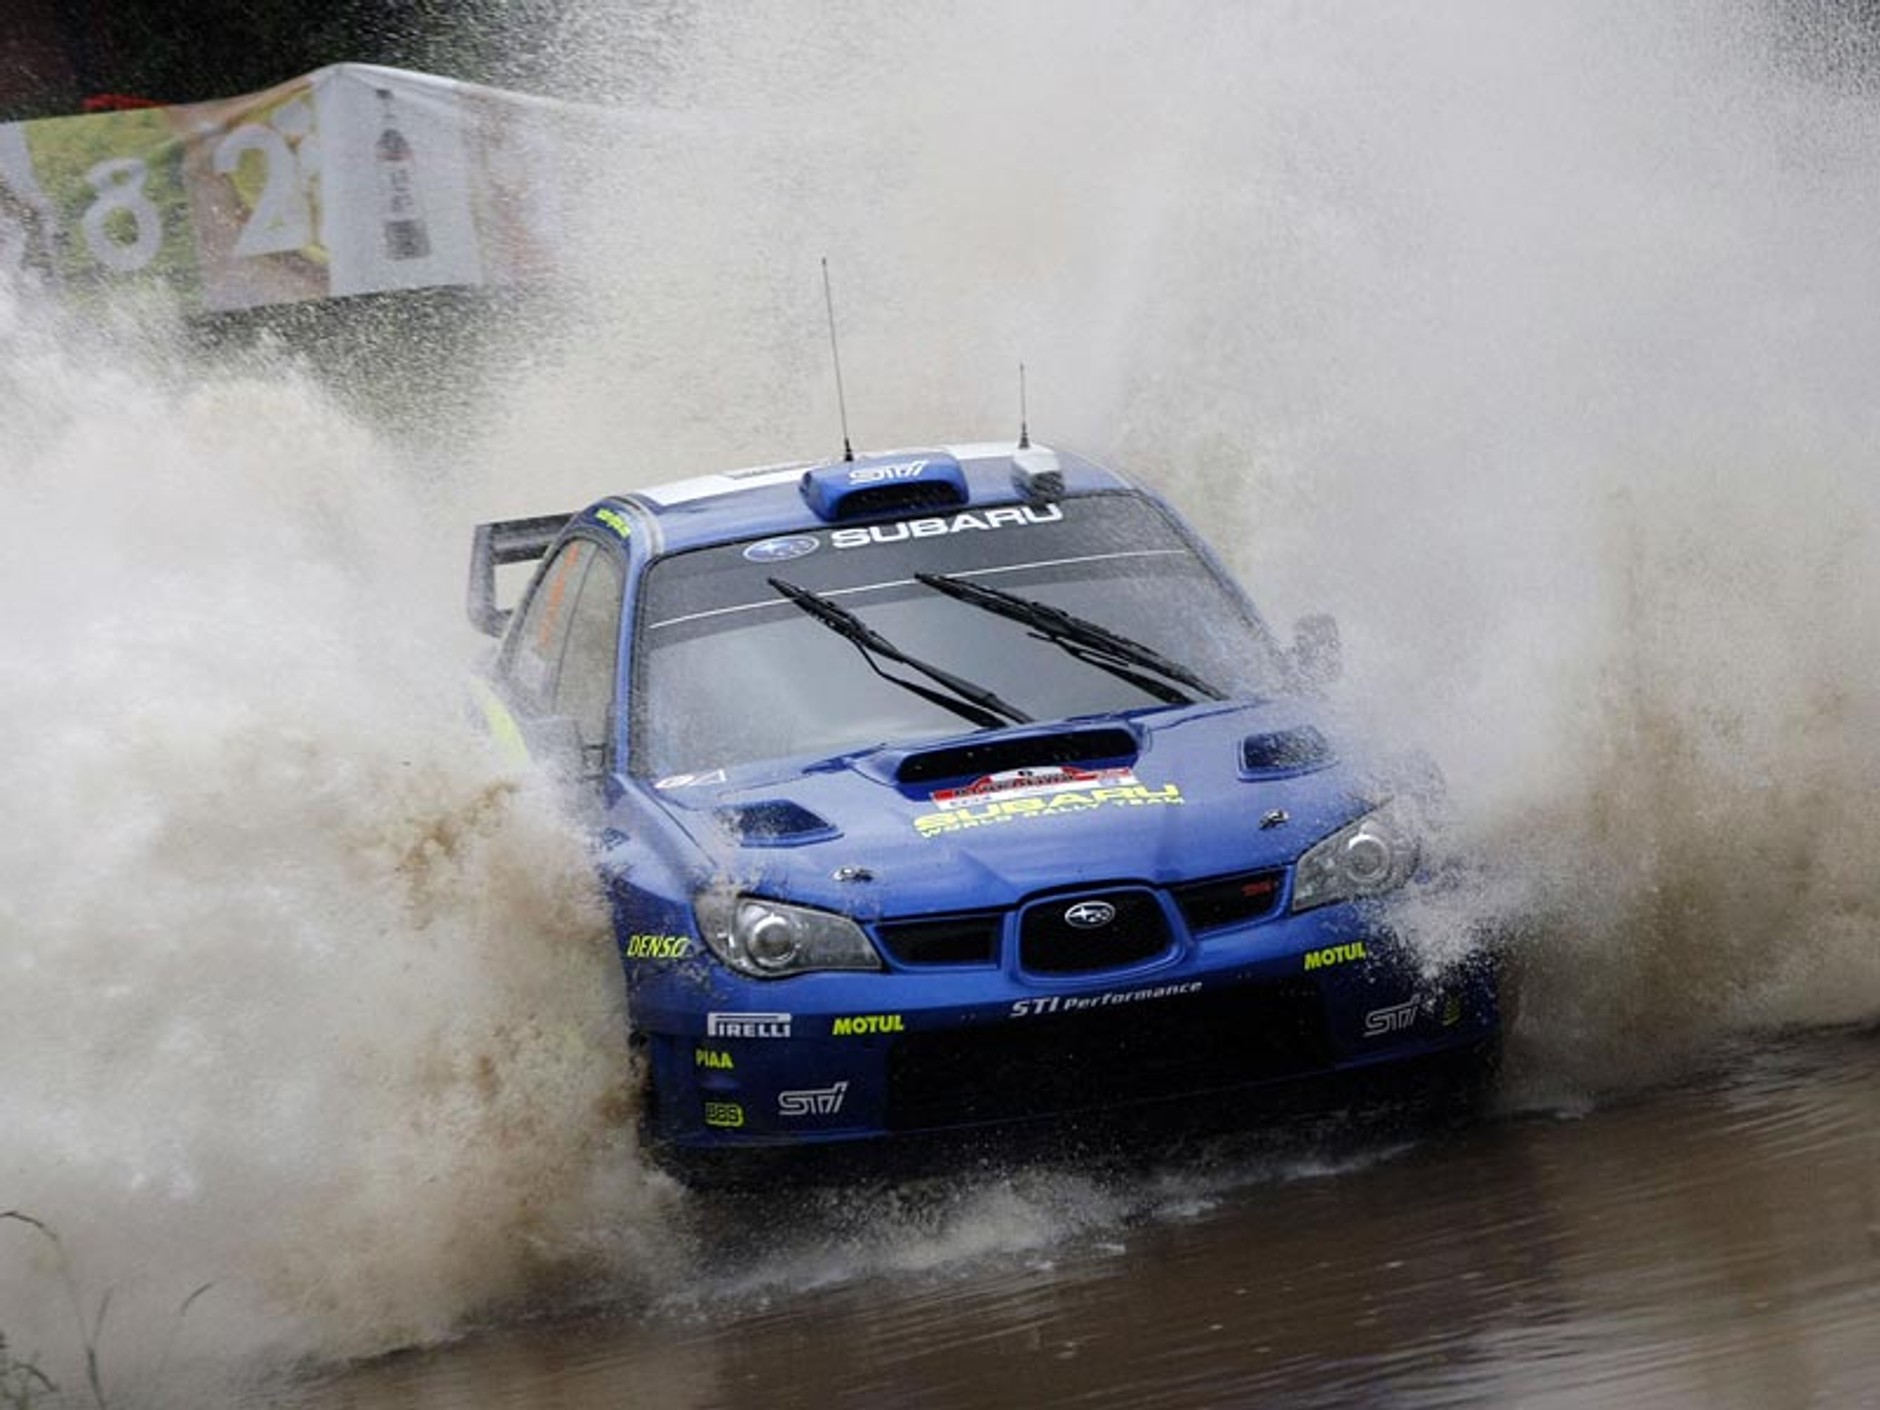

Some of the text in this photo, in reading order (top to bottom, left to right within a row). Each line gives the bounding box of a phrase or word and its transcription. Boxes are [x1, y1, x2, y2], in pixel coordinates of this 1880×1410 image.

[830, 502, 1064, 550] SUBARU
[914, 784, 1181, 831] SUBARU
[626, 934, 692, 958] DENSO
[1304, 941, 1367, 971] MOTUL
[1063, 981, 1203, 1011] Performance
[706, 1012, 792, 1038] PIRELLI
[832, 1014, 905, 1036] MOTUL
[695, 1048, 735, 1070] PIAA
